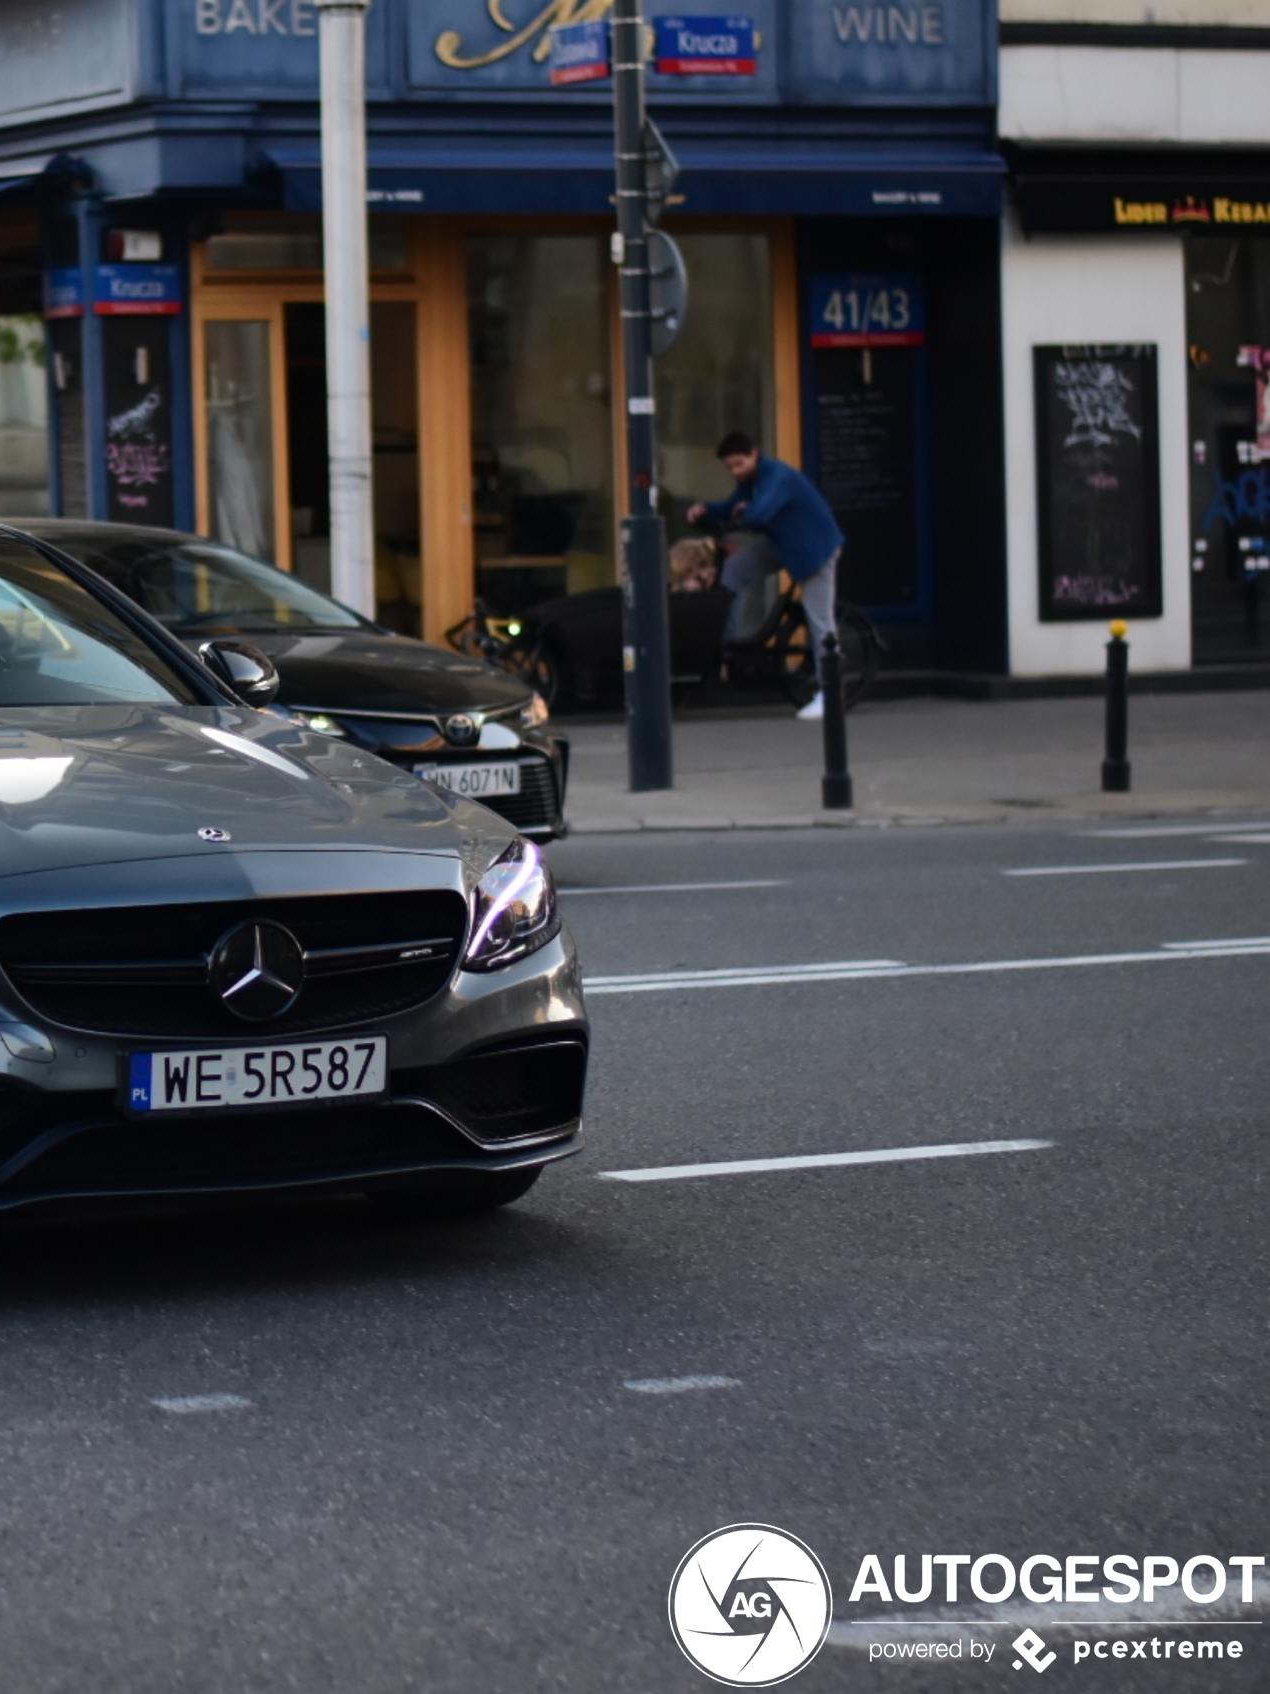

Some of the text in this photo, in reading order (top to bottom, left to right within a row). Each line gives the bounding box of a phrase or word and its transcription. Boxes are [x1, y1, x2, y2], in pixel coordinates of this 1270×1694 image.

[196, 0, 318, 36] BAKE
[833, 6, 943, 44] WINE
[677, 29, 739, 55] Krucza
[1213, 197, 1270, 224] KEBA
[822, 288, 912, 335] 41/43
[459, 767, 516, 793] 6071N
[164, 1042, 376, 1103] WE 5R587
[132, 1088, 148, 1101] PL
